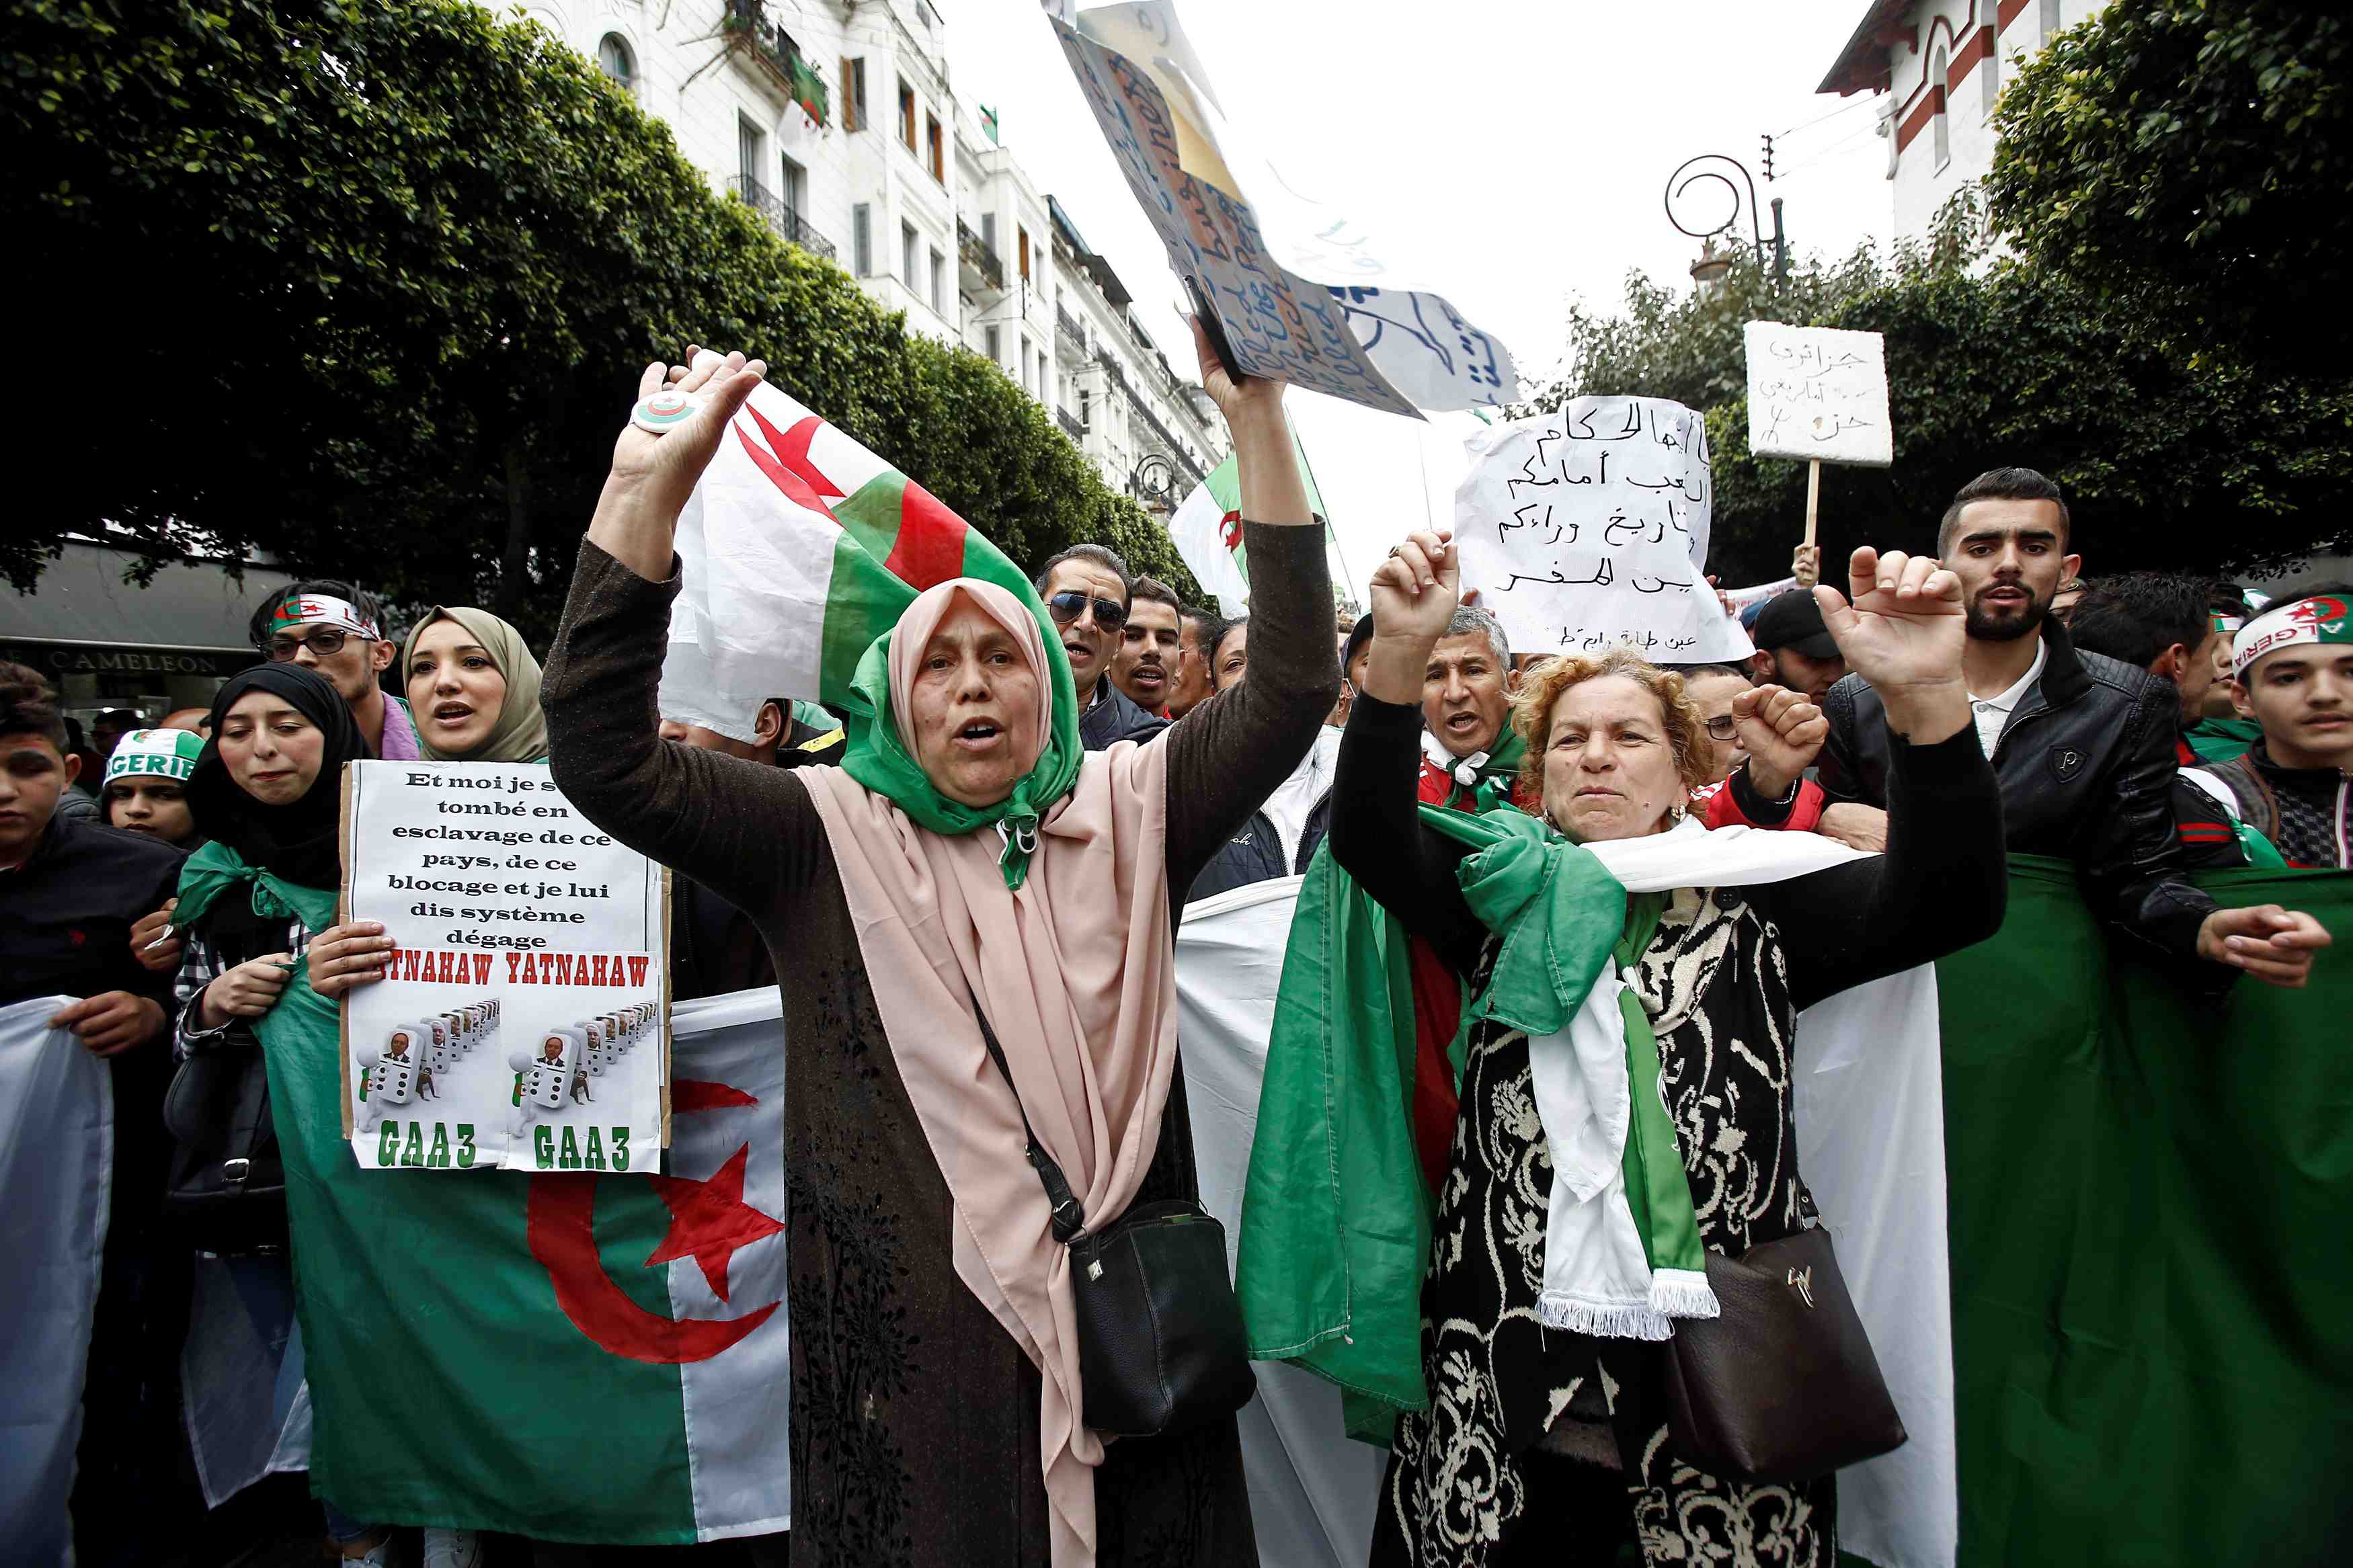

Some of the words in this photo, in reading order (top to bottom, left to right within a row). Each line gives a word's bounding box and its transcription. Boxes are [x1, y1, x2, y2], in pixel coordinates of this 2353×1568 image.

[1537, 402, 1642, 467] الحكام
[1507, 450, 1609, 499] أمامكم
[1494, 557, 1613, 591] المفر
[50, 651, 216, 672] CAMELEON
[106, 754, 196, 778] GERIE
[405, 773, 442, 787] Et
[448, 776, 504, 790] moi
[507, 777, 534, 794] je
[436, 800, 526, 817] tombé
[532, 807, 569, 818] en
[392, 825, 534, 846] esclavage
[539, 829, 574, 845] de
[580, 835, 612, 846] ce
[422, 854, 500, 870] pays,
[506, 854, 539, 869] de
[545, 858, 577, 871] ce
[388, 874, 498, 897] blocage
[504, 881, 530, 895] et
[534, 880, 565, 899] je
[568, 882, 612, 899] lui
[409, 902, 454, 917] dis
[461, 905, 586, 923] système
[446, 930, 547, 950] dégage
[381, 949, 493, 985] TNAHAW
[506, 952, 649, 987] YATNAHAW
[378, 1120, 476, 1169] GAA3
[534, 1124, 631, 1172] GAA3
